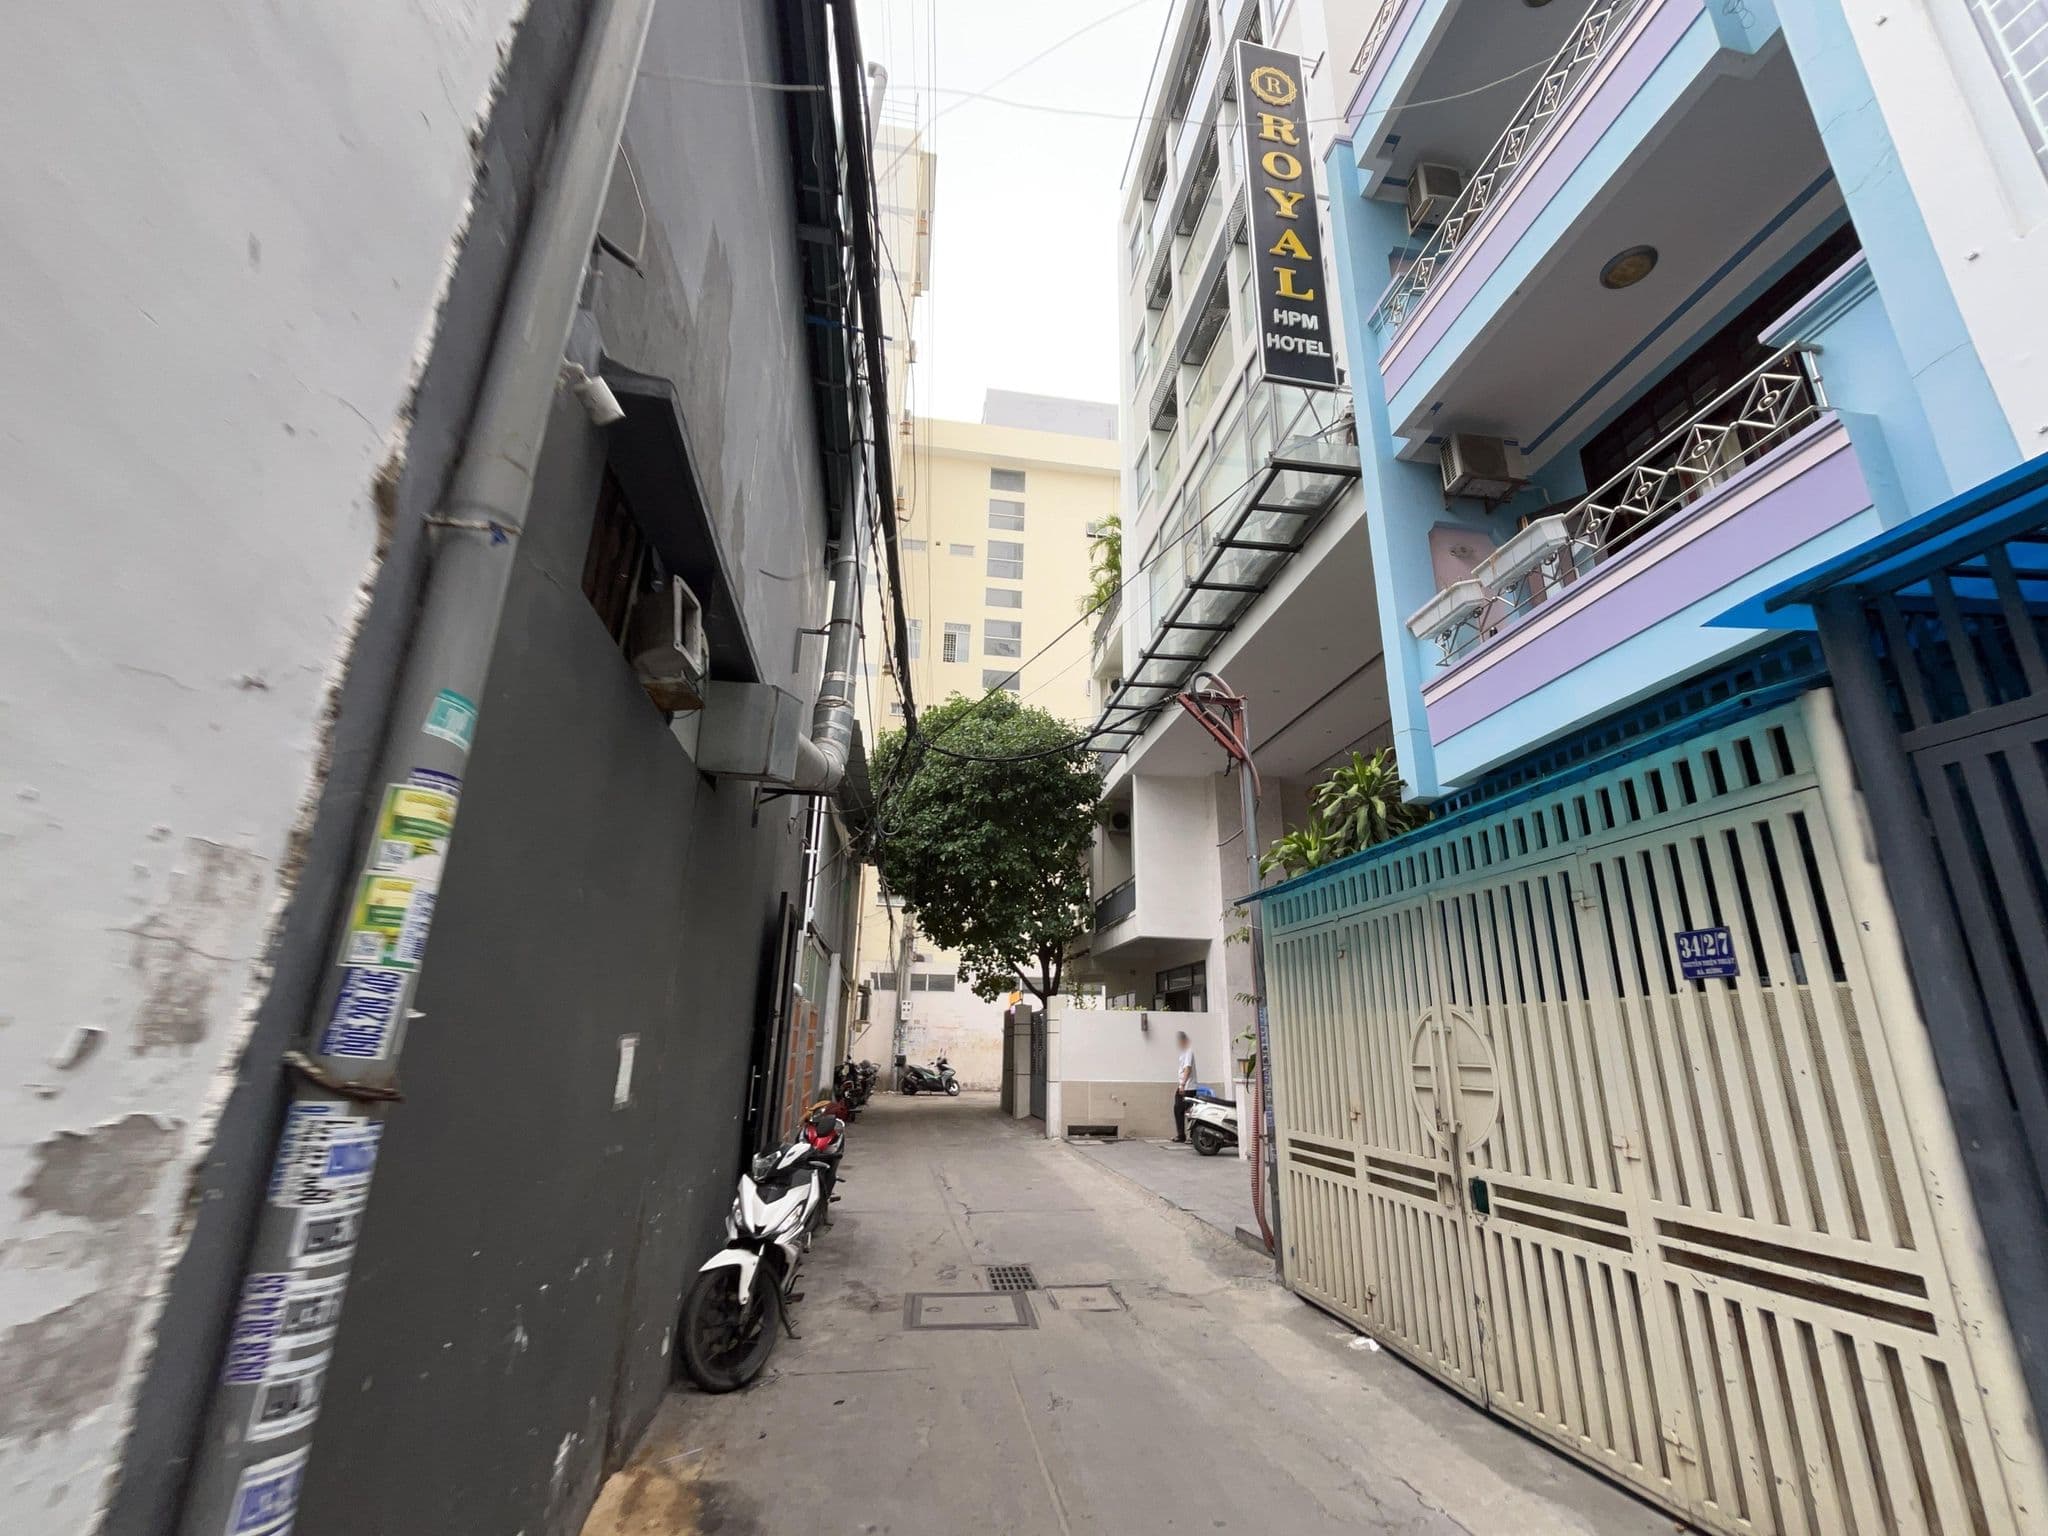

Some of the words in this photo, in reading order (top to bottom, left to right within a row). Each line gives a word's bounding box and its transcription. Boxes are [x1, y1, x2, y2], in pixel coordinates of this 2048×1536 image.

[1265, 75, 1283, 95] R
[1256, 111, 1315, 301] ROYAL
[1273, 308, 1319, 331] HPM
[1266, 332, 1331, 357] HOTEL
